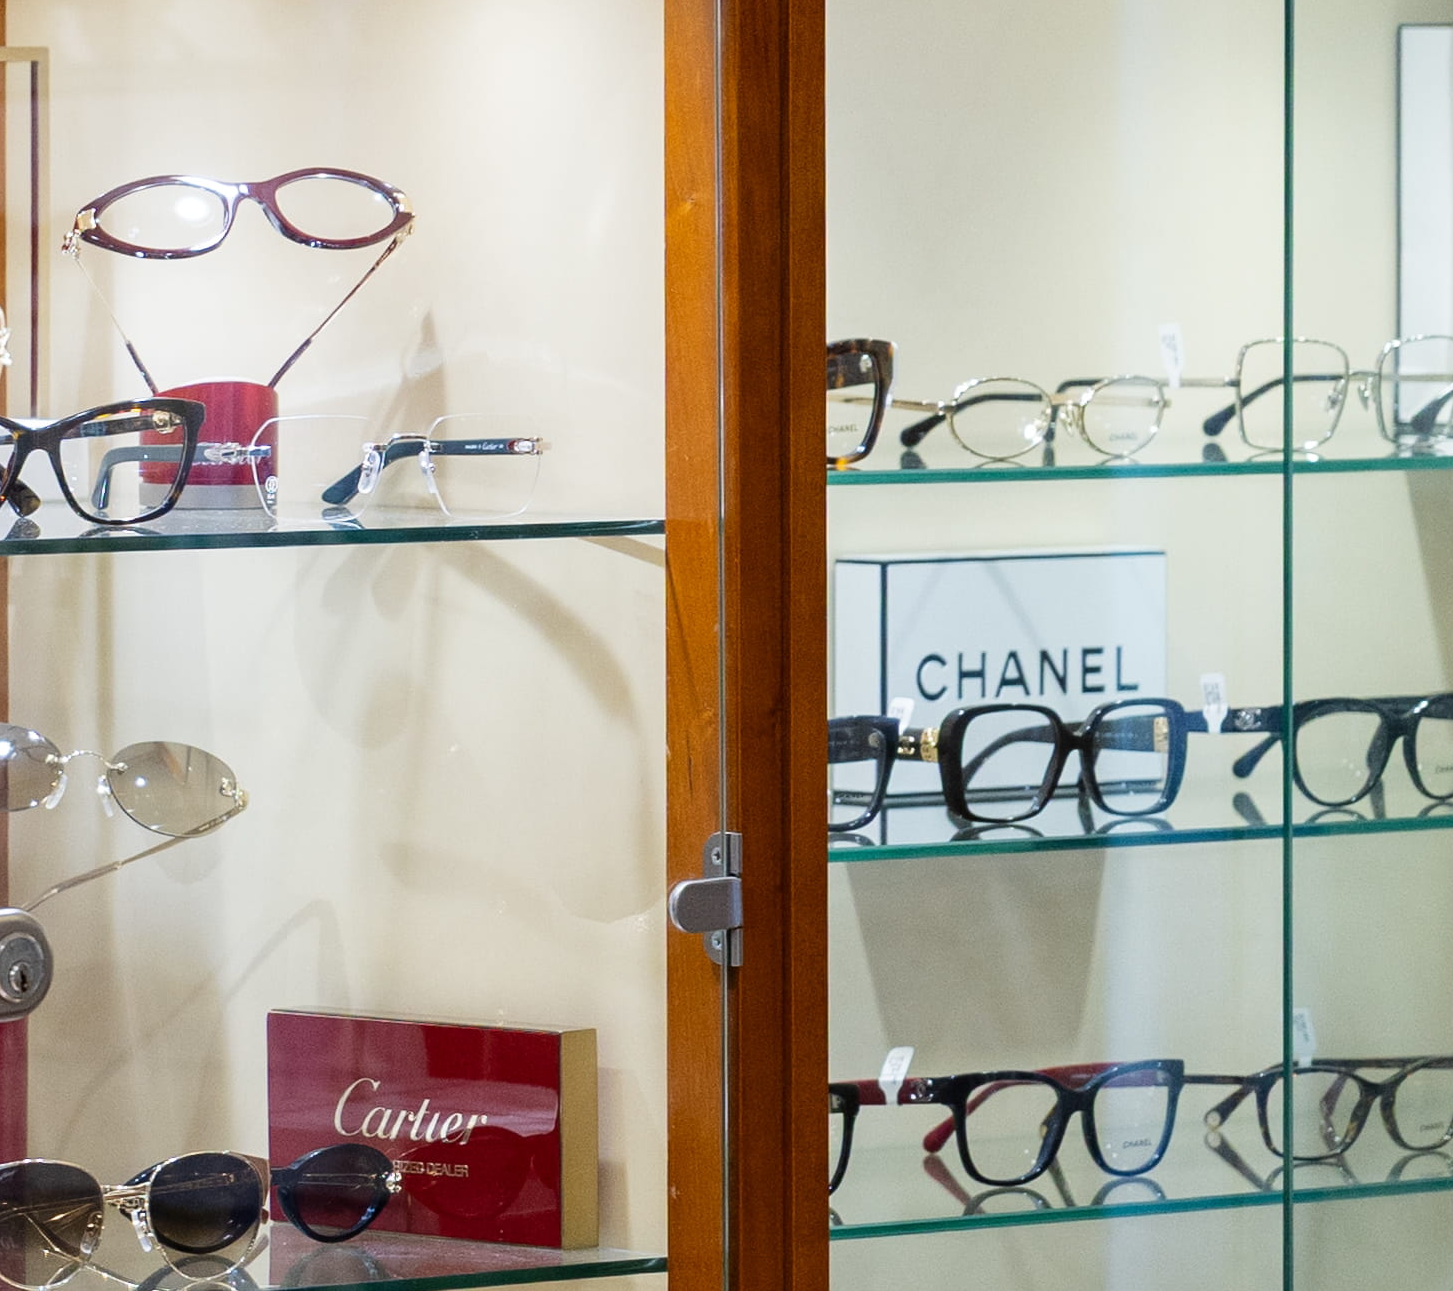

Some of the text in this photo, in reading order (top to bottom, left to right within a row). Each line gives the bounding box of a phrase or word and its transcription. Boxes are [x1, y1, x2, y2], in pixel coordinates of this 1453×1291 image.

[916, 645, 1140, 701] CHANEL
[334, 1077, 488, 1146] Cartier
[427, 1161, 470, 1178] DEALER
